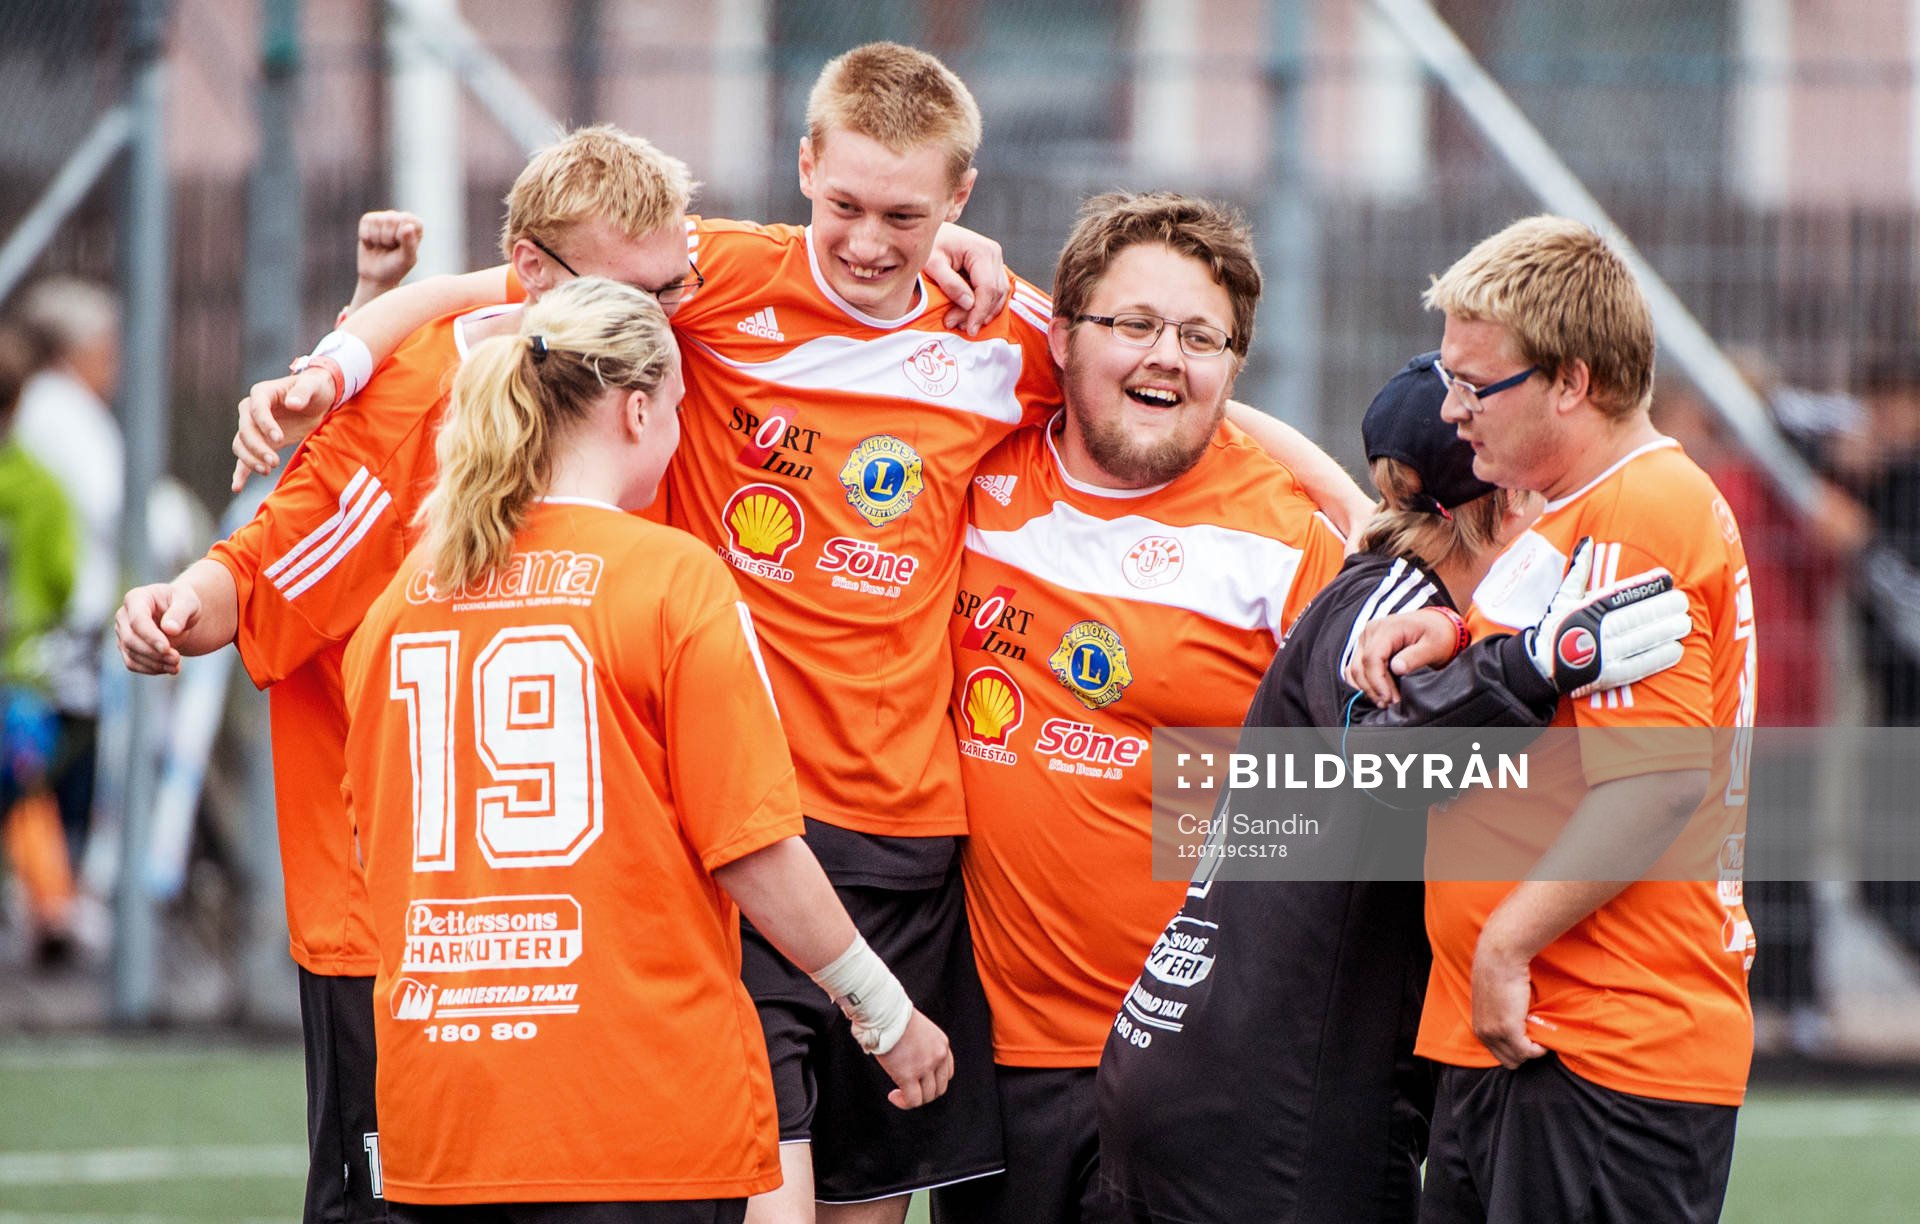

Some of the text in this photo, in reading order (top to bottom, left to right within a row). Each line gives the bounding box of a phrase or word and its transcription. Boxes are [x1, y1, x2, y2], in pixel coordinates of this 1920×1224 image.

[737, 321, 785, 343] adidas
[728, 406, 821, 455] SPORT
[861, 439, 911, 460] LIONS
[760, 450, 814, 481] Inn
[870, 461, 894, 495] L
[975, 475, 1012, 506] adidas
[717, 546, 794, 582] MARIESTAD
[816, 536, 919, 584] Söne
[1611, 579, 1666, 606] uhlsport
[953, 590, 1034, 635] SPORT
[980, 630, 1027, 661] Inn
[1071, 624, 1115, 648] LIONS
[1078, 647, 1101, 684] L
[390, 624, 604, 872] 19
[1034, 717, 1144, 766] Söne
[412, 905, 558, 935] Petterssons
[437, 984, 579, 1006] MARIESTAD TAXI
[1158, 999, 1188, 1019] TAXI
[424, 1022, 538, 1042] 180 80
[1114, 1011, 1152, 1049] 180 80
